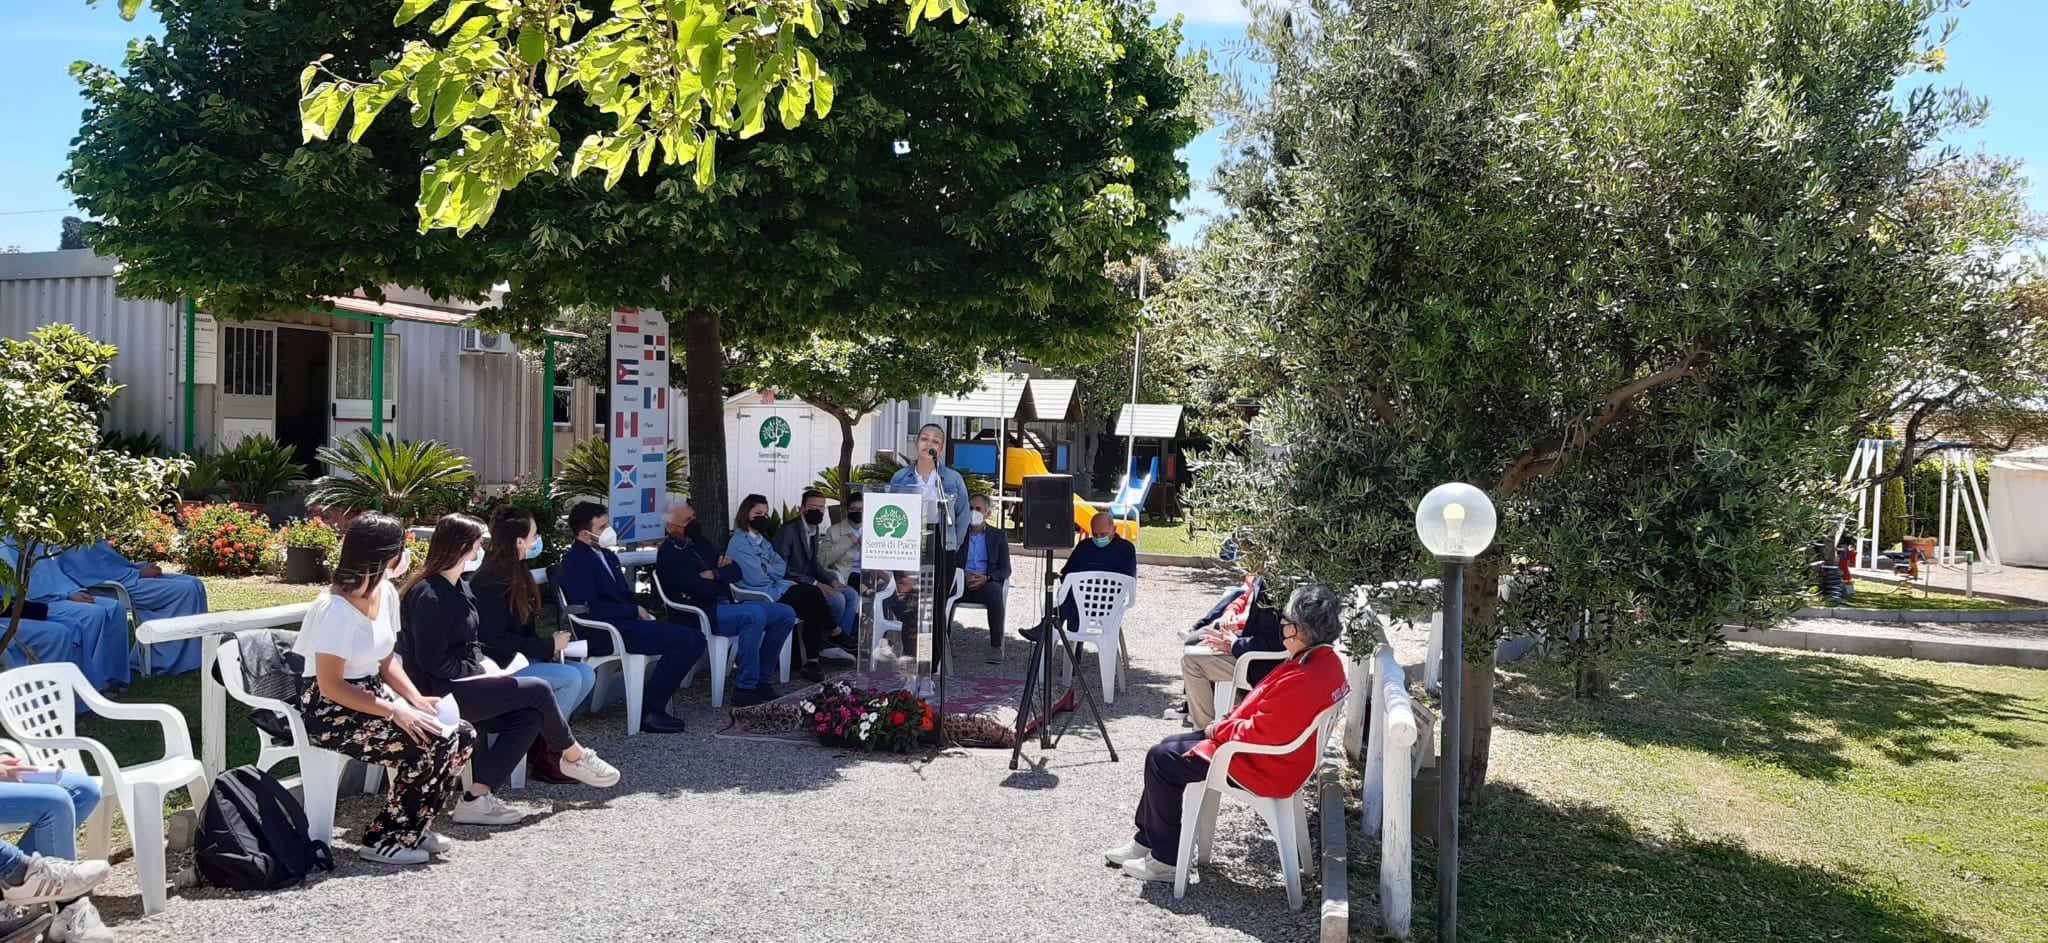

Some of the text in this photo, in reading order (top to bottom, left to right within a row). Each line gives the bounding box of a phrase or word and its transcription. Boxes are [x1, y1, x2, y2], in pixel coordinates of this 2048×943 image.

[865, 539, 917, 549] Semi di Pace
